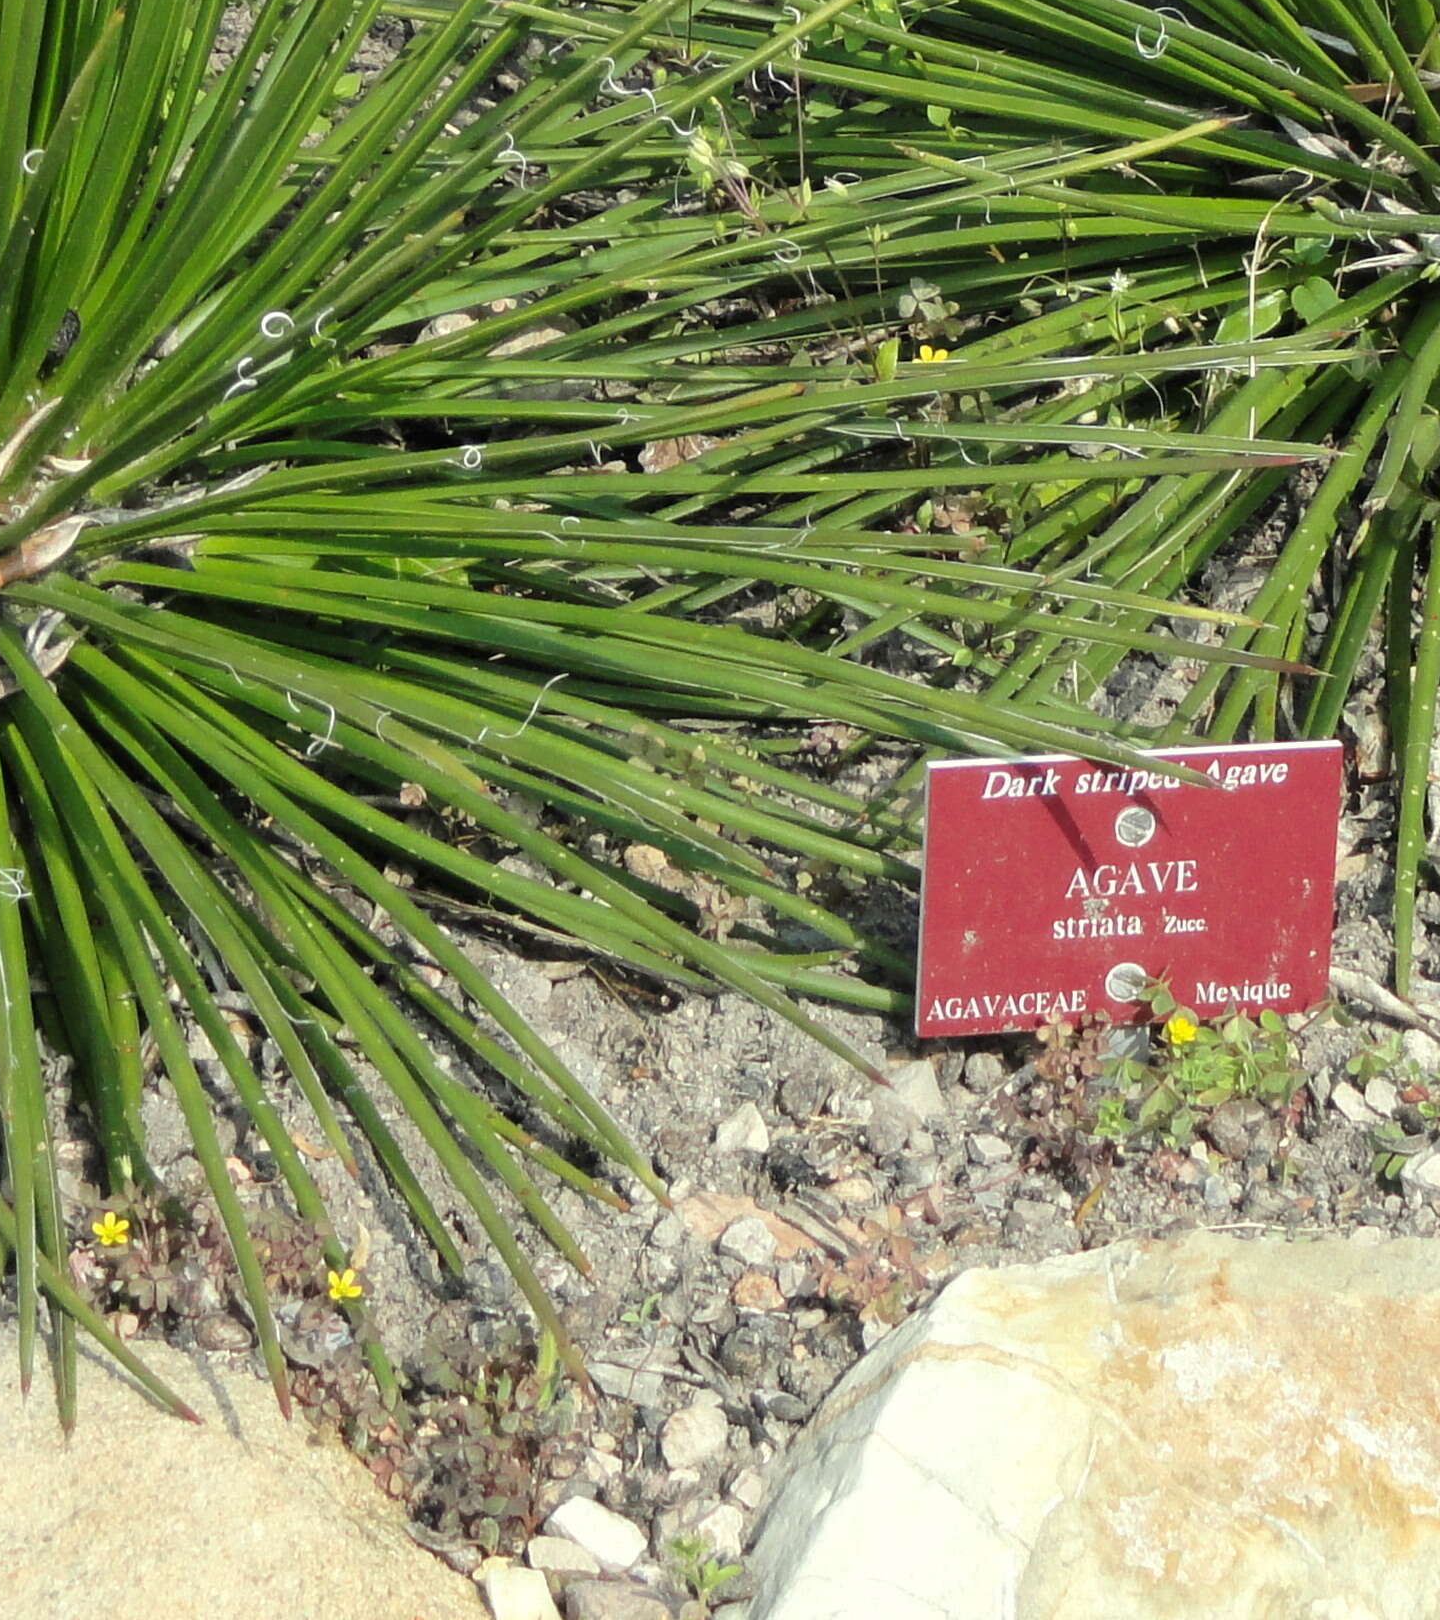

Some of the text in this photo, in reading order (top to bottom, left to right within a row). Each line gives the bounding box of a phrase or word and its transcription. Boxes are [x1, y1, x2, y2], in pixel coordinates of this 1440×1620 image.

[981, 768, 1062, 800] Dark
[1205, 759, 1290, 791] Agave
[1064, 859, 1199, 899] AGAVE
[1052, 913, 1144, 940] striata
[926, 989, 1088, 1022] AGAVACEAE
[1195, 979, 1293, 1005] Mexique
